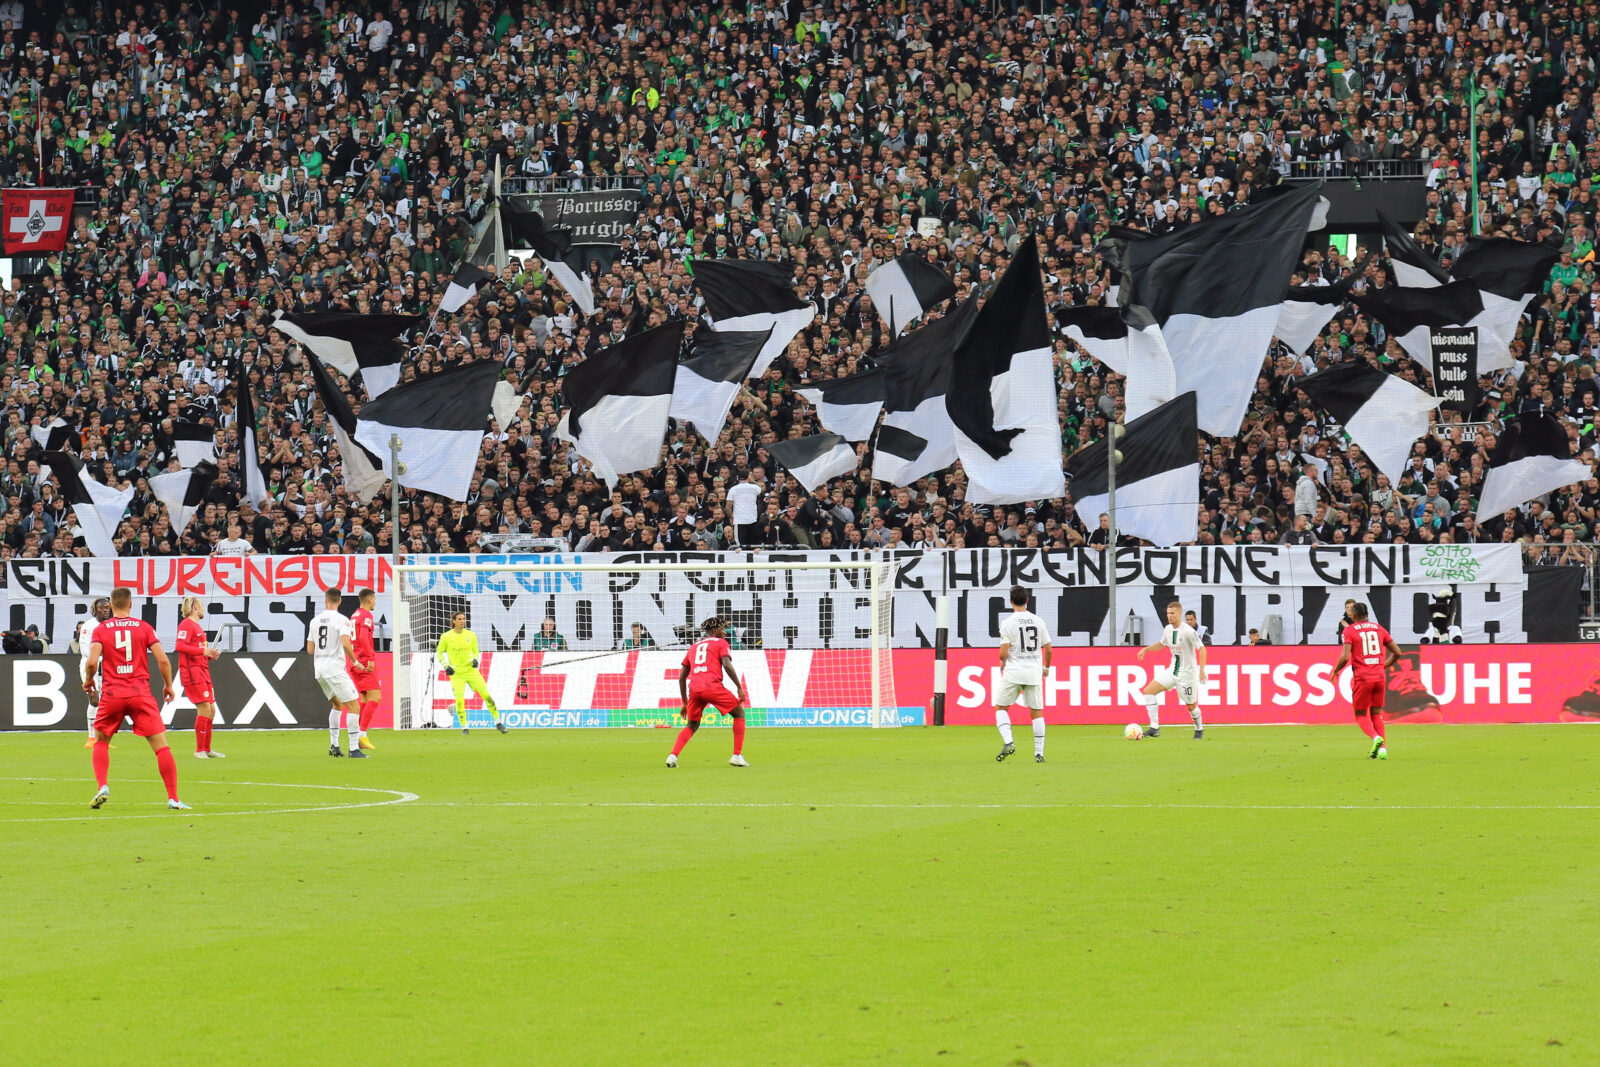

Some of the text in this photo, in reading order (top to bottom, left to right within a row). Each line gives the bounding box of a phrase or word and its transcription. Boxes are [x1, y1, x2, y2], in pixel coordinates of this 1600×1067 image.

[1432, 332, 1475, 346] niemand
[1440, 352, 1468, 363] muss
[1439, 366, 1468, 381] bulle
[1443, 386, 1465, 401] sein
[1419, 557, 1482, 569] CULTURA
[11, 559, 90, 597] EIN
[1309, 545, 1410, 585] EIN!
[1425, 568, 1476, 582] ULTRAS
[318, 625, 328, 649] 8
[1018, 626, 1038, 652] 13
[1359, 630, 1381, 656] 18
[114, 629, 132, 662] 4
[694, 642, 709, 665] 8
[1182, 686, 1193, 696] 30
